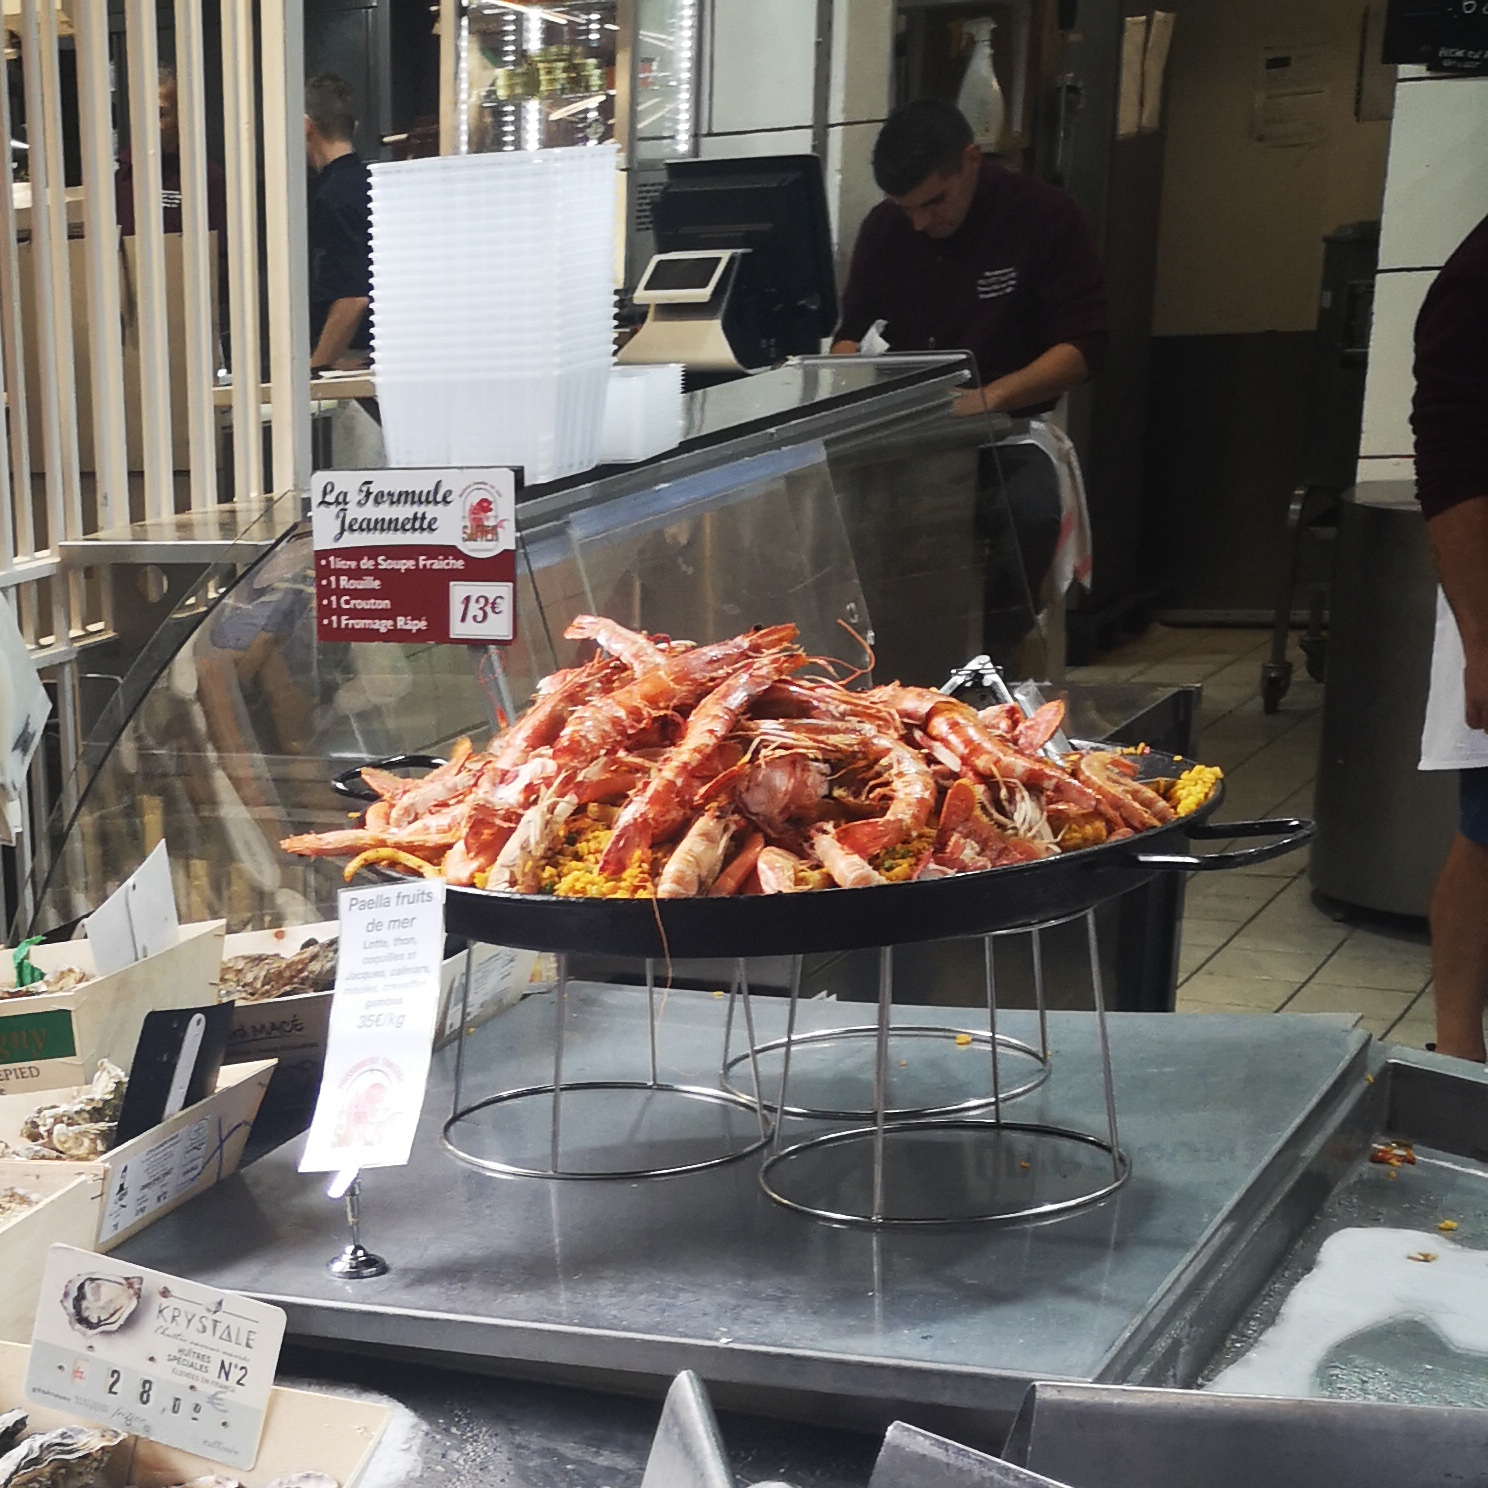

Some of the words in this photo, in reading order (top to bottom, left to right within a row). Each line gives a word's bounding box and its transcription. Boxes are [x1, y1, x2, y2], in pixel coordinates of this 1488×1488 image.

[316, 481, 350, 508] La
[357, 479, 454, 508] Formule
[333, 507, 440, 543] Jeannette
[359, 556, 375, 570] de
[377, 556, 416, 573] Soupe
[418, 555, 465, 570] Fraîche
[329, 576, 336, 589] 1
[339, 576, 382, 590] Rouille
[330, 596, 337, 609] 1
[340, 596, 391, 610] Crouton
[460, 594, 504, 624] 13€
[331, 616, 338, 629] 1
[340, 616, 394, 633] Fromage
[396, 615, 428, 633] Râpé
[348, 895, 391, 911] Paella
[395, 890, 433, 906] fruits
[366, 918, 382, 933] de
[387, 916, 417, 930] mer
[357, 1013, 406, 1029] 35€/kg
[156, 1303, 257, 1349] KRYSTALE
